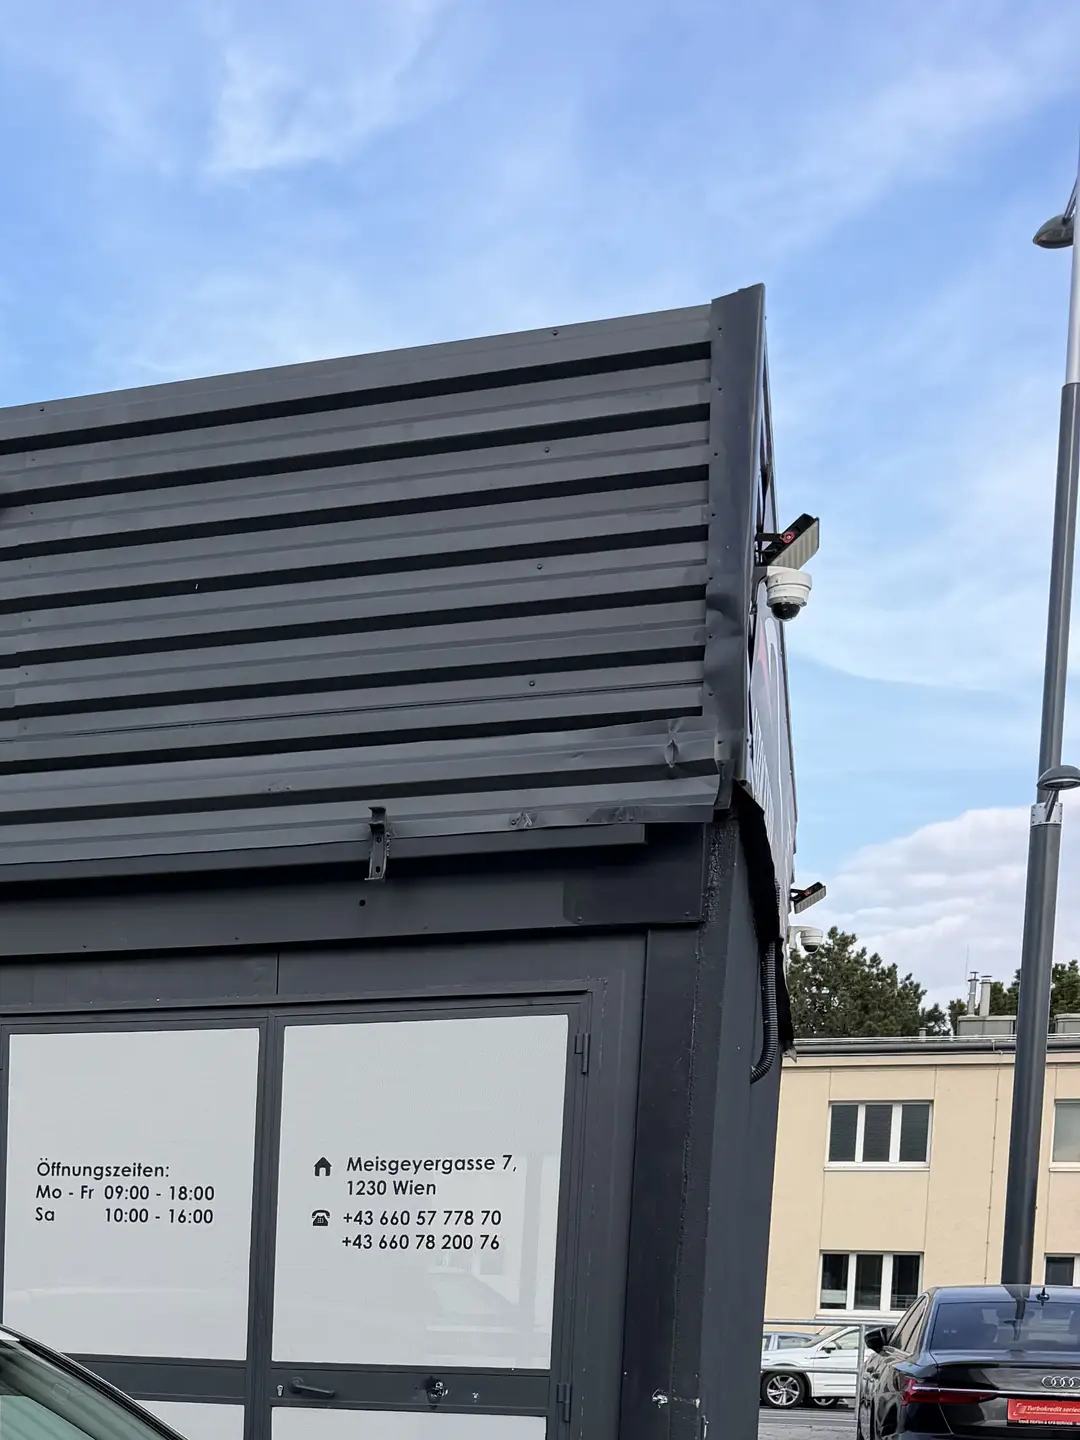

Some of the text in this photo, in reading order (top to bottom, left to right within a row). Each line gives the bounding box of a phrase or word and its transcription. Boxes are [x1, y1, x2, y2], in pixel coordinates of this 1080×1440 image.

[37, 1158, 169, 1180] Öffnungszeiten:
[347, 1155, 518, 1175] Meisgeyergasse 7,
[36, 1185, 61, 1199] Mo
[81, 1185, 94, 1199] Fr
[105, 1185, 149, 1199] 09:00
[170, 1186, 214, 1200] 18:00
[348, 1180, 435, 1195] 1230 Wien
[35, 1207, 54, 1221] Sa
[106, 1208, 148, 1222] 10:00
[169, 1209, 213, 1223] 16:00
[344, 1210, 501, 1225] +43 660 57 778 70
[342, 1234, 499, 1250] +43 660 78 200 76
